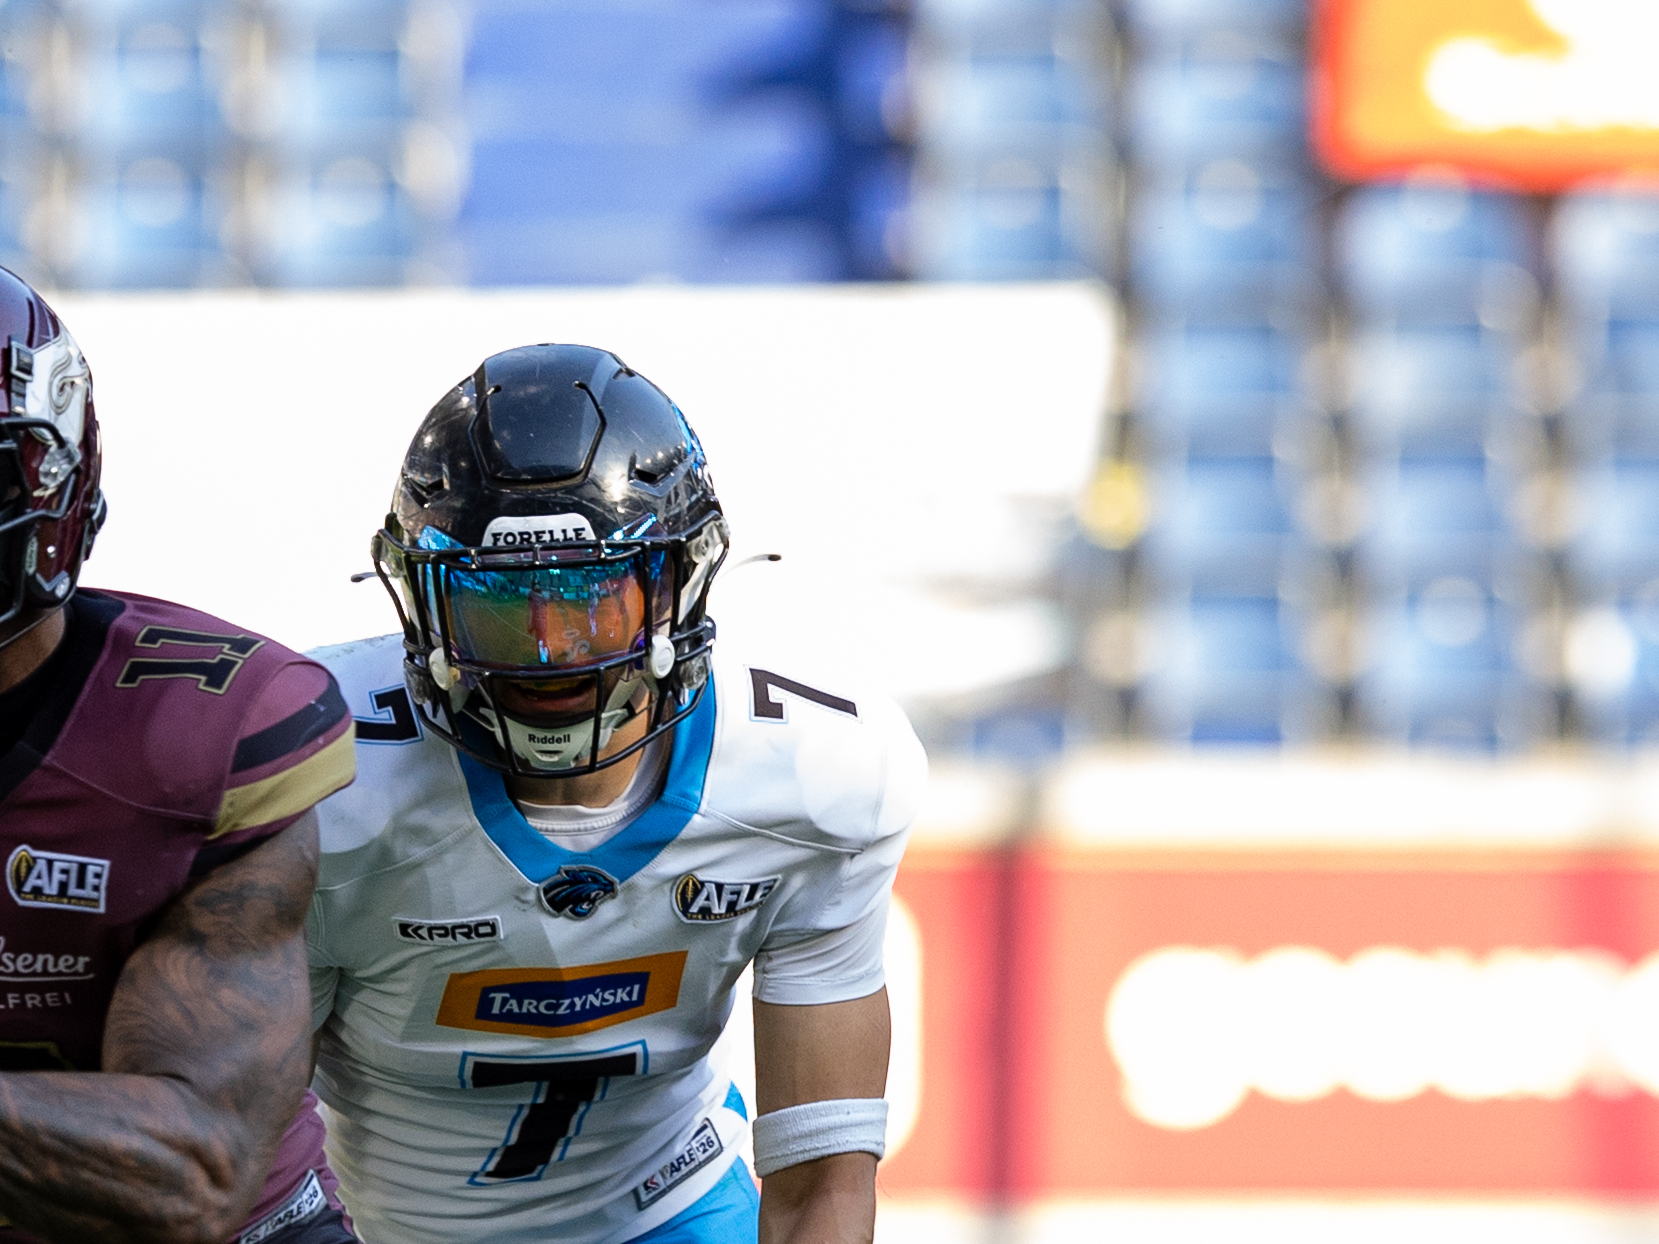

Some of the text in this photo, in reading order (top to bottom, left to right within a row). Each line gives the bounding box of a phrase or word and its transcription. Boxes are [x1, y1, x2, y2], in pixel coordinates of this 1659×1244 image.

[490, 526, 587, 547] FORELLE
[115, 625, 267, 695] 11
[743, 664, 862, 724] 7
[527, 733, 571, 745] Riddell
[21, 857, 104, 900] AFLE
[688, 880, 775, 914] AFLE
[488, 983, 641, 1015] TARCZYŃSKI
[458, 1038, 649, 1187] 7
[669, 1147, 696, 1177] AFLE
